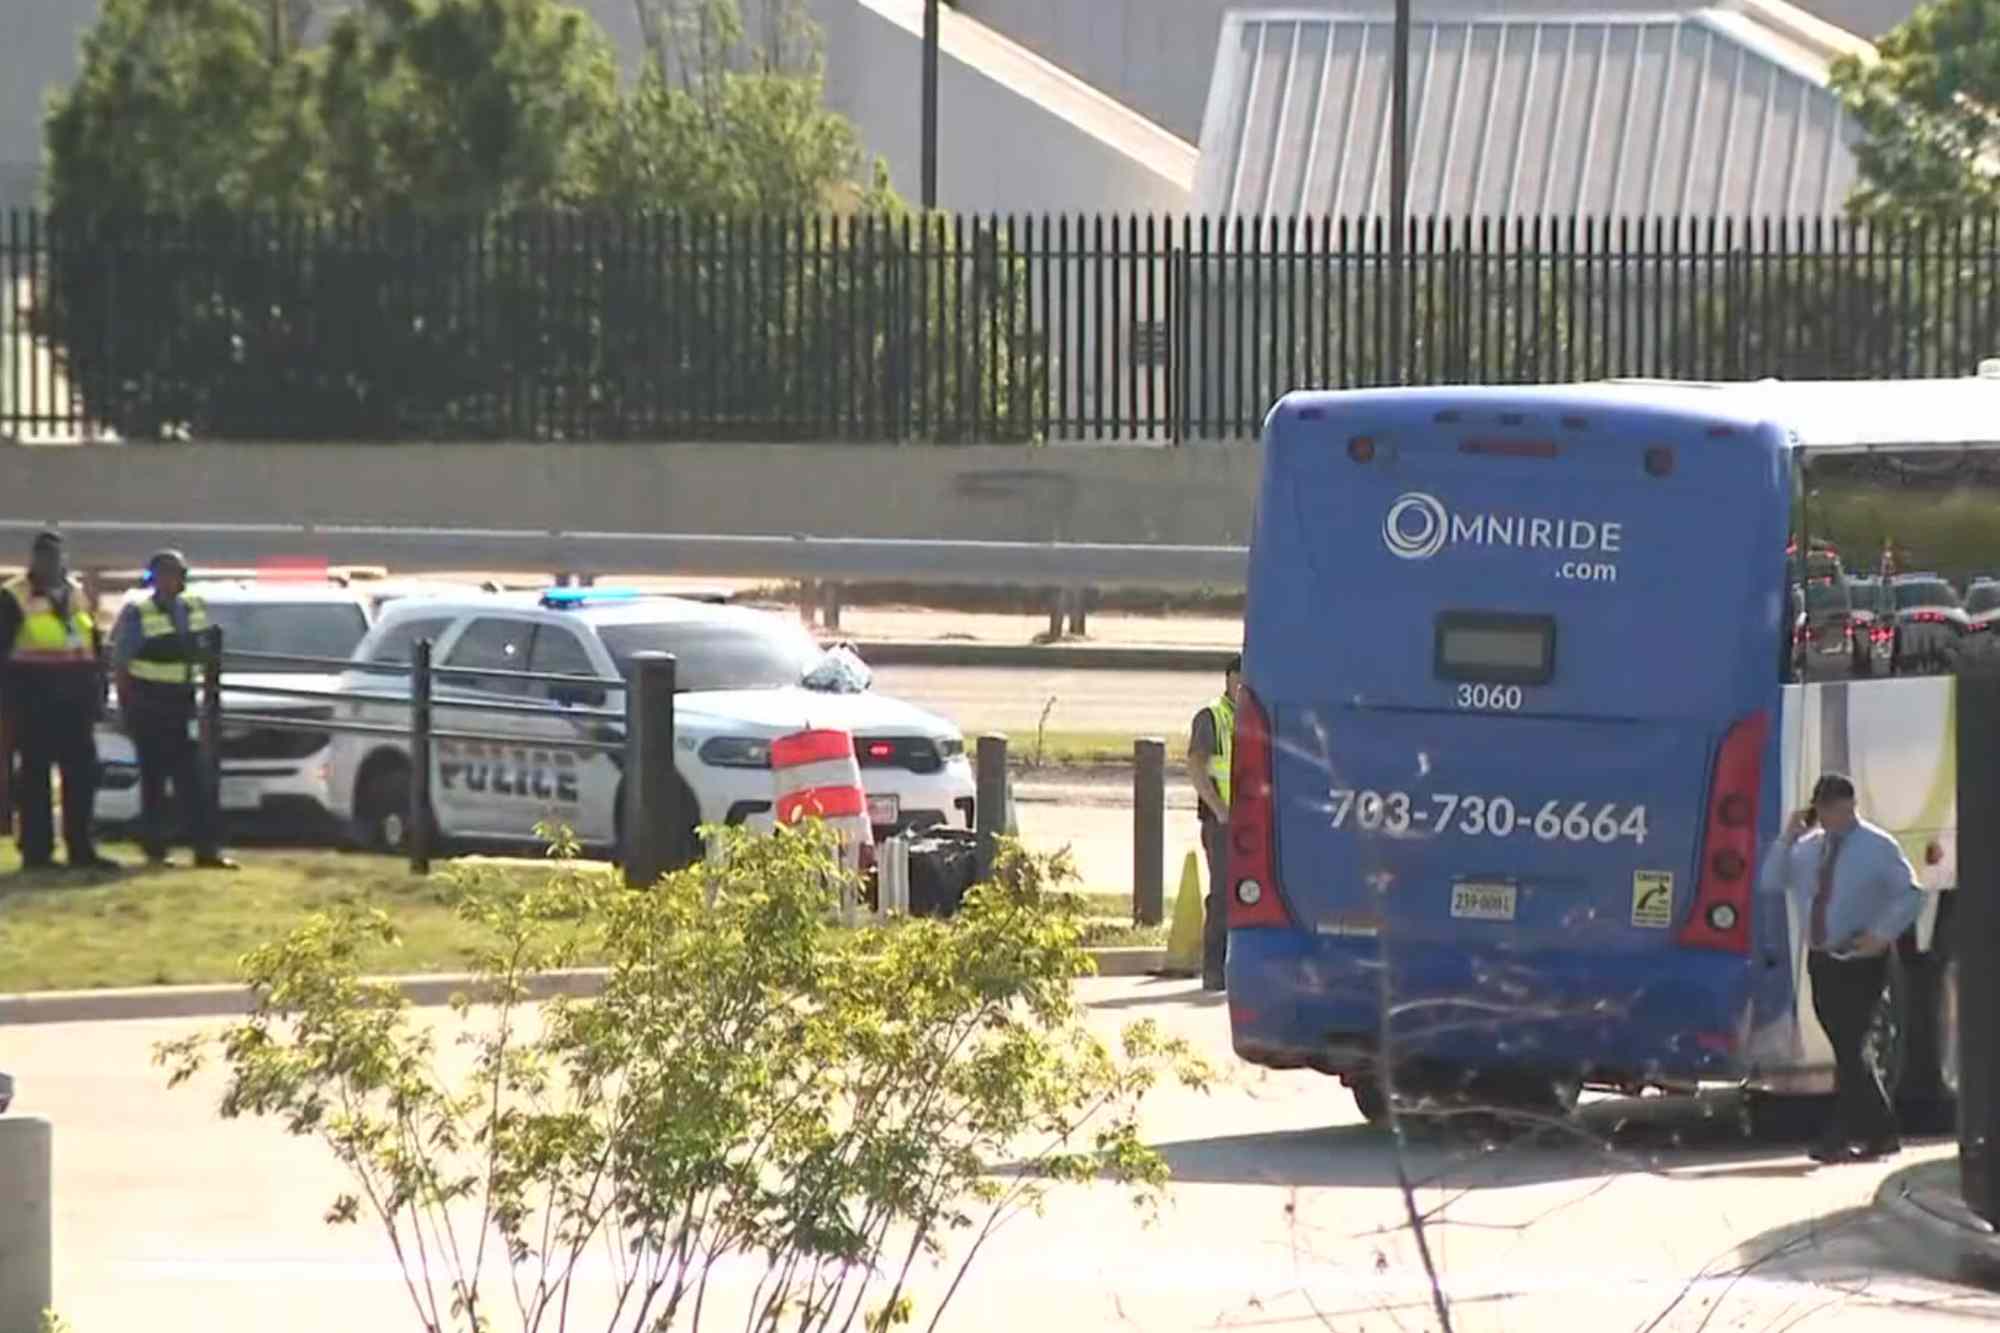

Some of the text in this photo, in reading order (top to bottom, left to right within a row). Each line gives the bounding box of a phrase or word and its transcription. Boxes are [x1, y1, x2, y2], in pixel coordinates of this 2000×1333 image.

[1554, 561, 1617, 582] .com
[1456, 684, 1522, 710] 3060
[440, 748, 579, 803] POLICE
[1328, 789, 1649, 844] 703-730-6664
